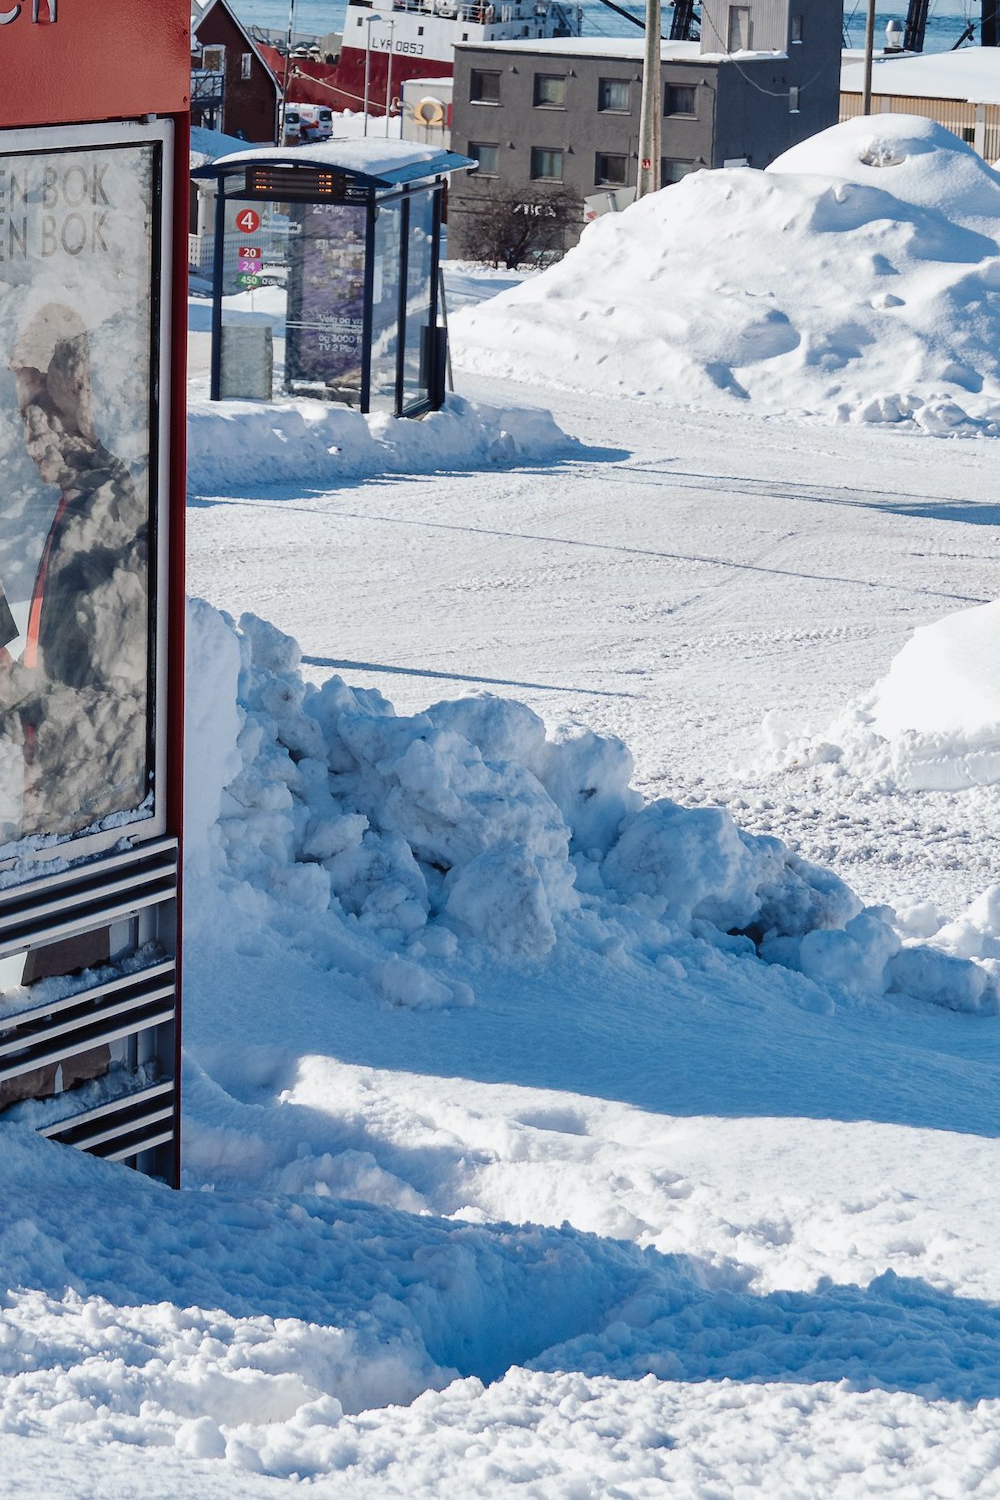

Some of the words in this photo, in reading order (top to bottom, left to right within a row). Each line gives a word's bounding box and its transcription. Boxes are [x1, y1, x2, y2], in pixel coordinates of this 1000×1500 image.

[396, 41, 424, 54] 0853
[43, 163, 110, 210] BOK
[325, 205, 345, 216] Play
[241, 212, 254, 230] 4
[41, 211, 109, 258] BOK
[244, 248, 256, 258] 20
[242, 262, 256, 270] 24
[240, 276, 258, 284] 450
[318, 336, 330, 344] og
[332, 335, 354, 343] 3000
